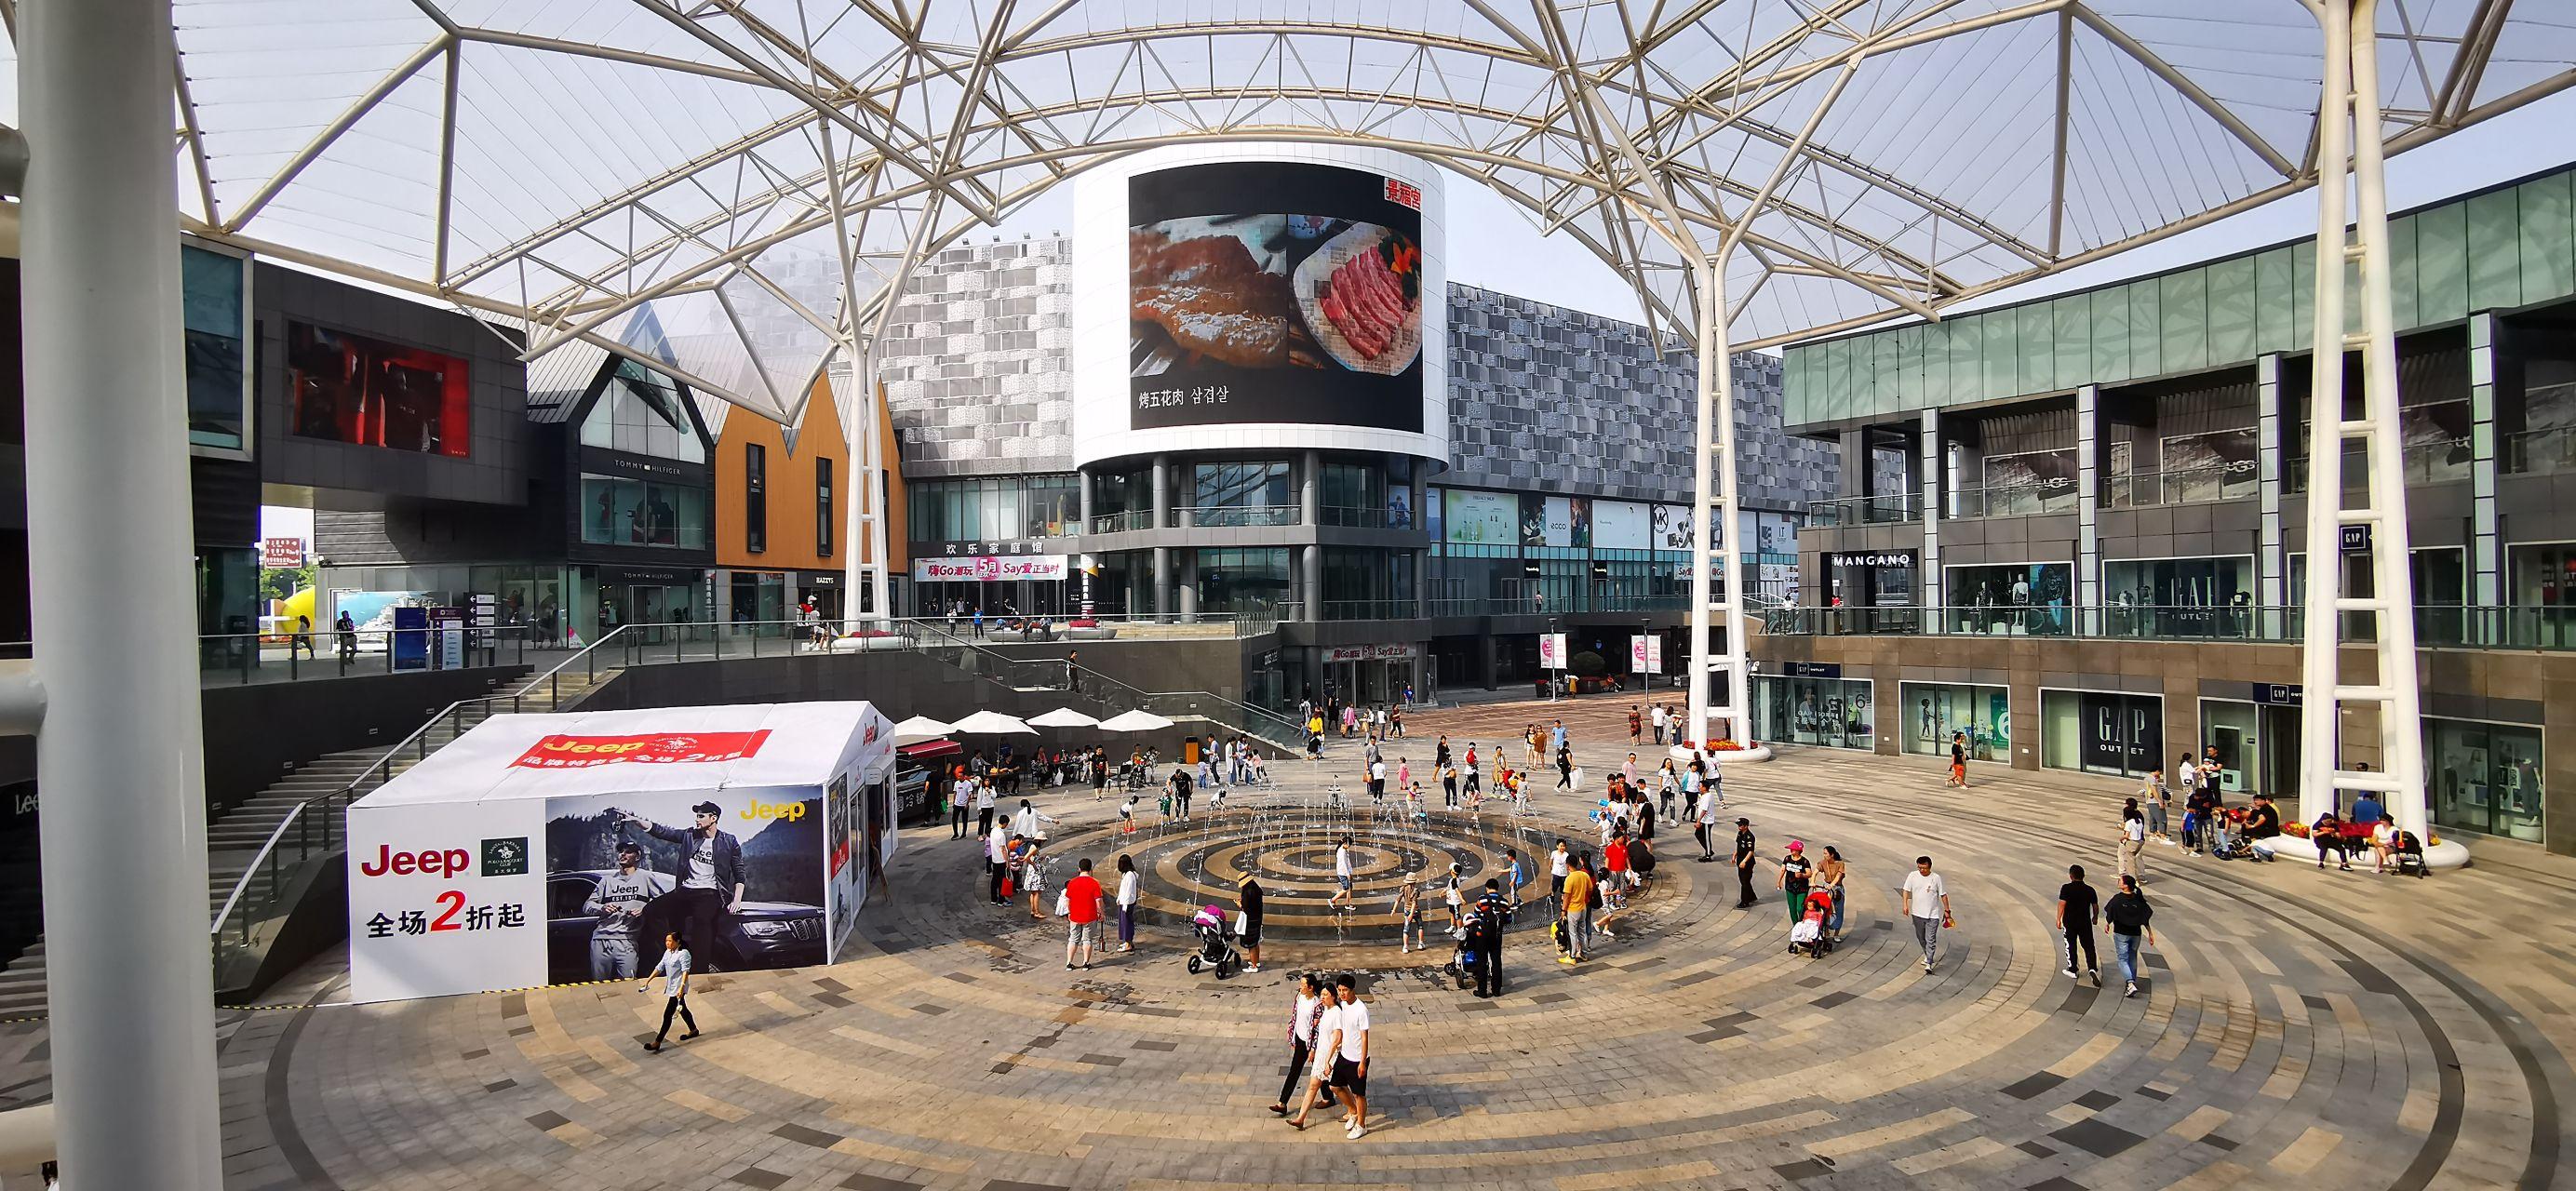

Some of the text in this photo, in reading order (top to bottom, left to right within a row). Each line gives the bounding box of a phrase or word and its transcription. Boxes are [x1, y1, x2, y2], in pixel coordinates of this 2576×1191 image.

[1138, 385, 1228, 409] 烤五花肉 삼겹살
[615, 460, 681, 475] TOMMY HILFIGER
[2226, 460, 2256, 473] UGG
[2345, 532, 2361, 543] GAP
[946, 542, 1044, 555] 欢乐家庭馆
[1833, 555, 1910, 567] MANGANO
[2274, 689, 2286, 699] GAP
[544, 740, 646, 754] Jeep
[2100, 743, 2145, 756] OUTET
[740, 798, 806, 823] Jeep
[361, 844, 470, 879] Jeep
[611, 885, 639, 894] Jeep
[366, 890, 526, 939] 全场2折起
